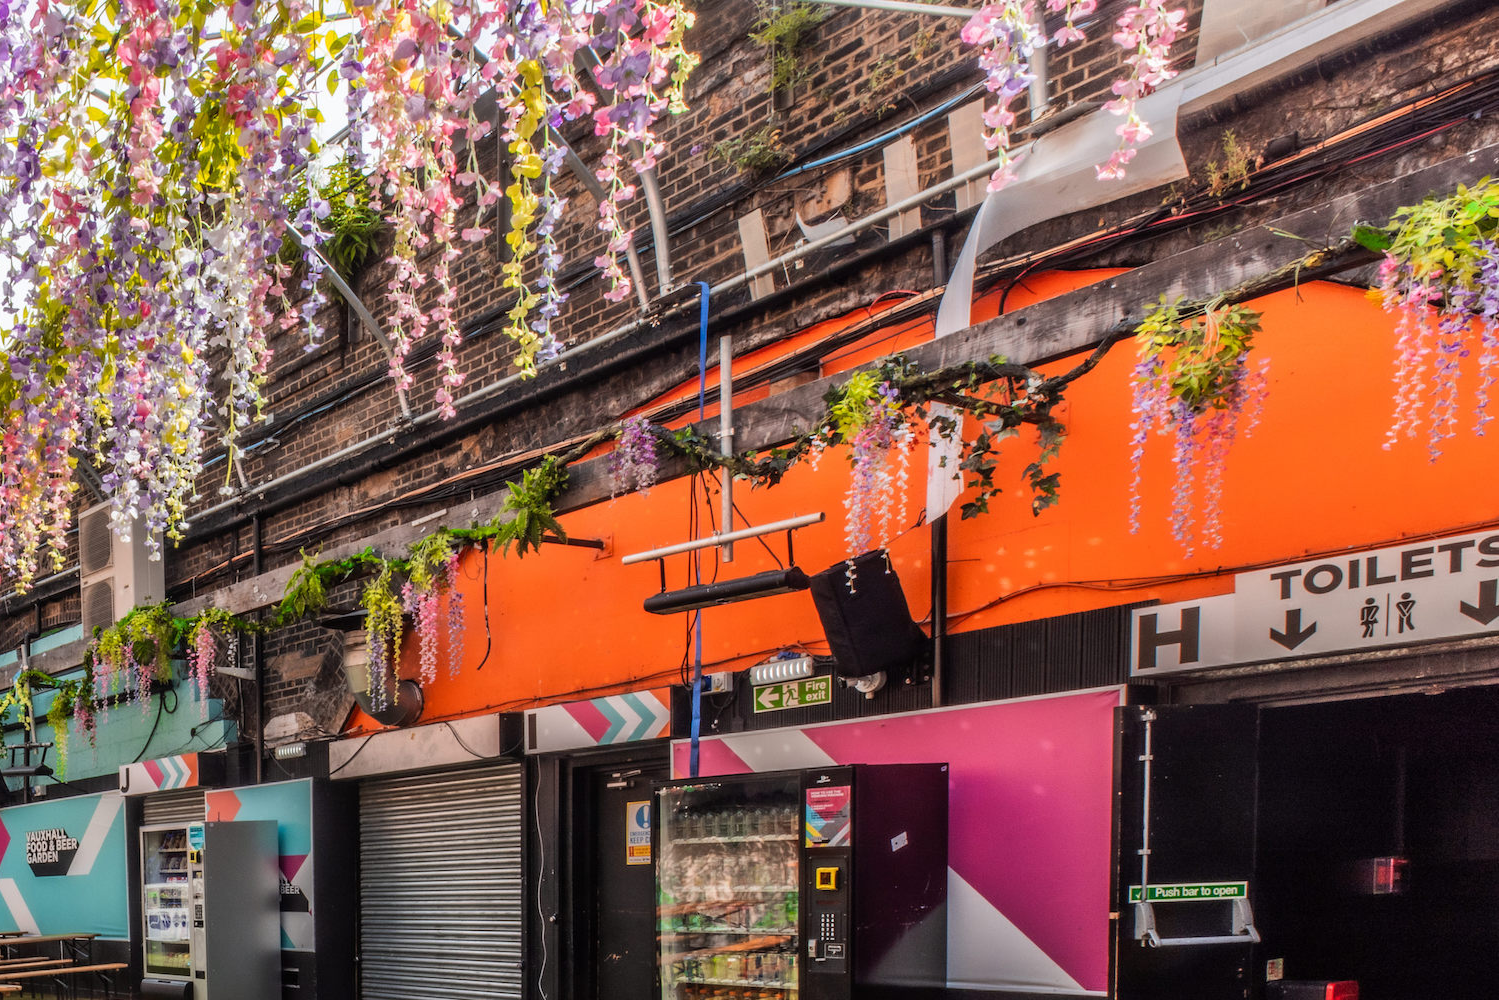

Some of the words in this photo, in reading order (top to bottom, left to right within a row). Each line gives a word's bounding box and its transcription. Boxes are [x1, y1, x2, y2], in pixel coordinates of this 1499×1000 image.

[1269, 535, 1499, 600] TOILETS
[1138, 606, 1200, 670] H
[805, 681, 826, 692] Fire
[805, 690, 826, 701] exit
[120, 767, 130, 793] J
[25, 828, 67, 843] VAUXHALL
[26, 841, 48, 853] FOOD
[49, 840, 55, 851] &
[55, 838, 77, 851] BEER
[26, 850, 59, 864] GARDEN
[1155, 887, 1180, 898] Push
[1182, 886, 1199, 897] bar
[1200, 886, 1211, 896] to
[1213, 886, 1238, 897] open
